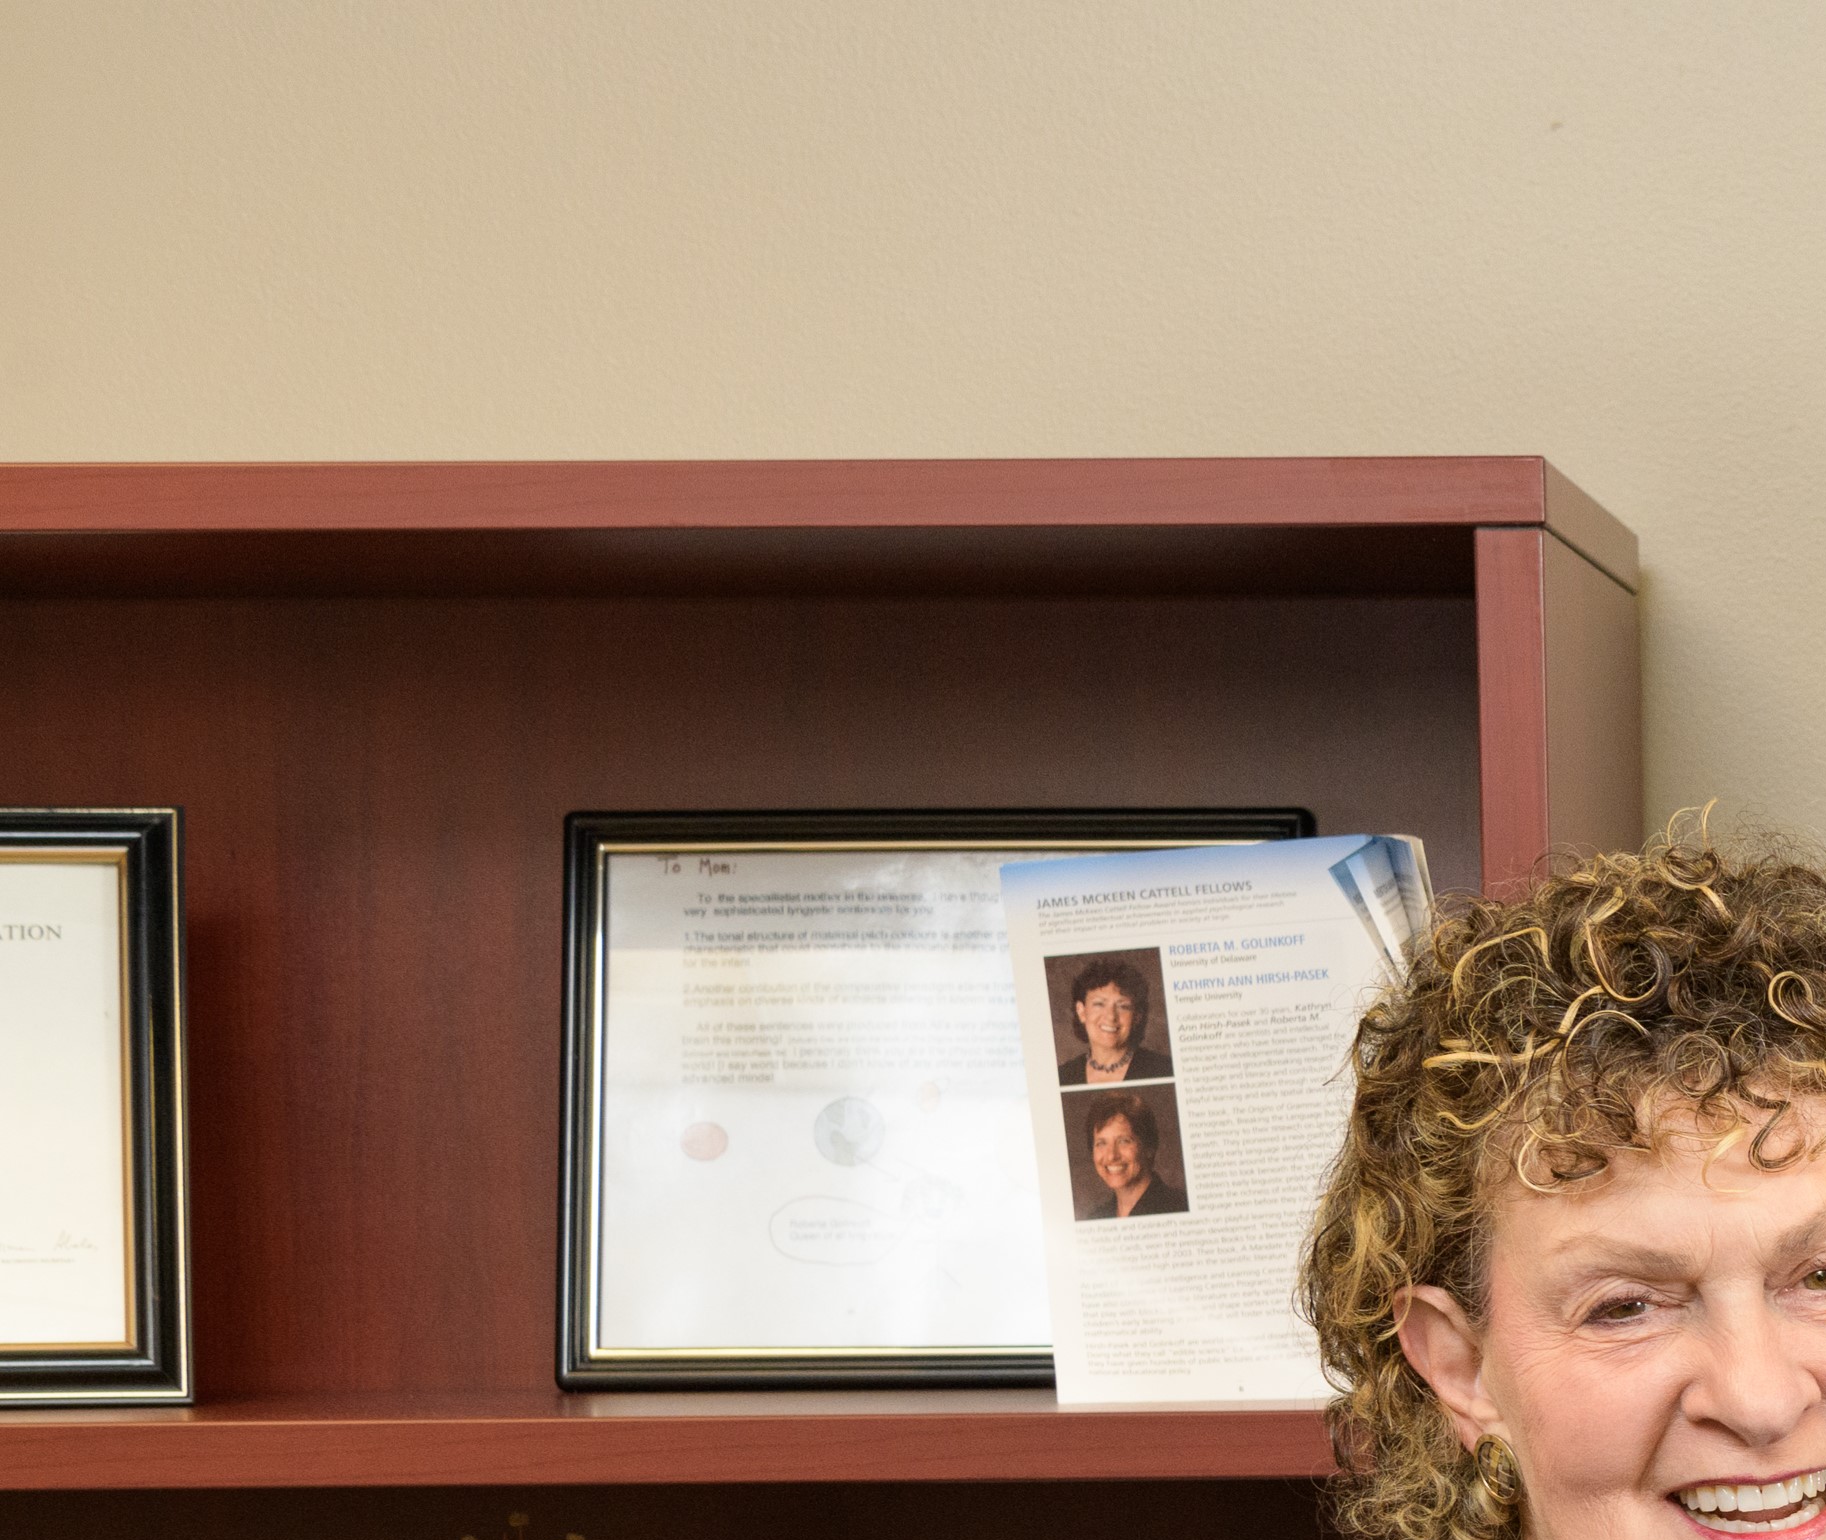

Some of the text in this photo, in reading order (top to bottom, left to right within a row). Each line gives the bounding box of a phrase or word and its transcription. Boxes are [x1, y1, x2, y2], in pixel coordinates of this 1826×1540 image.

[658, 855, 682, 875] To
[1037, 880, 1253, 910] JAMES MCKEEN CATTELL FELLOWS
[1168, 933, 1306, 956] ROBERTA M. GOLINKOFF
[1170, 952, 1258, 969] University of Delaware
[1172, 968, 1330, 992] KATHRYN ANN HIRSH-PASEK
[1206, 990, 1244, 1003] University
